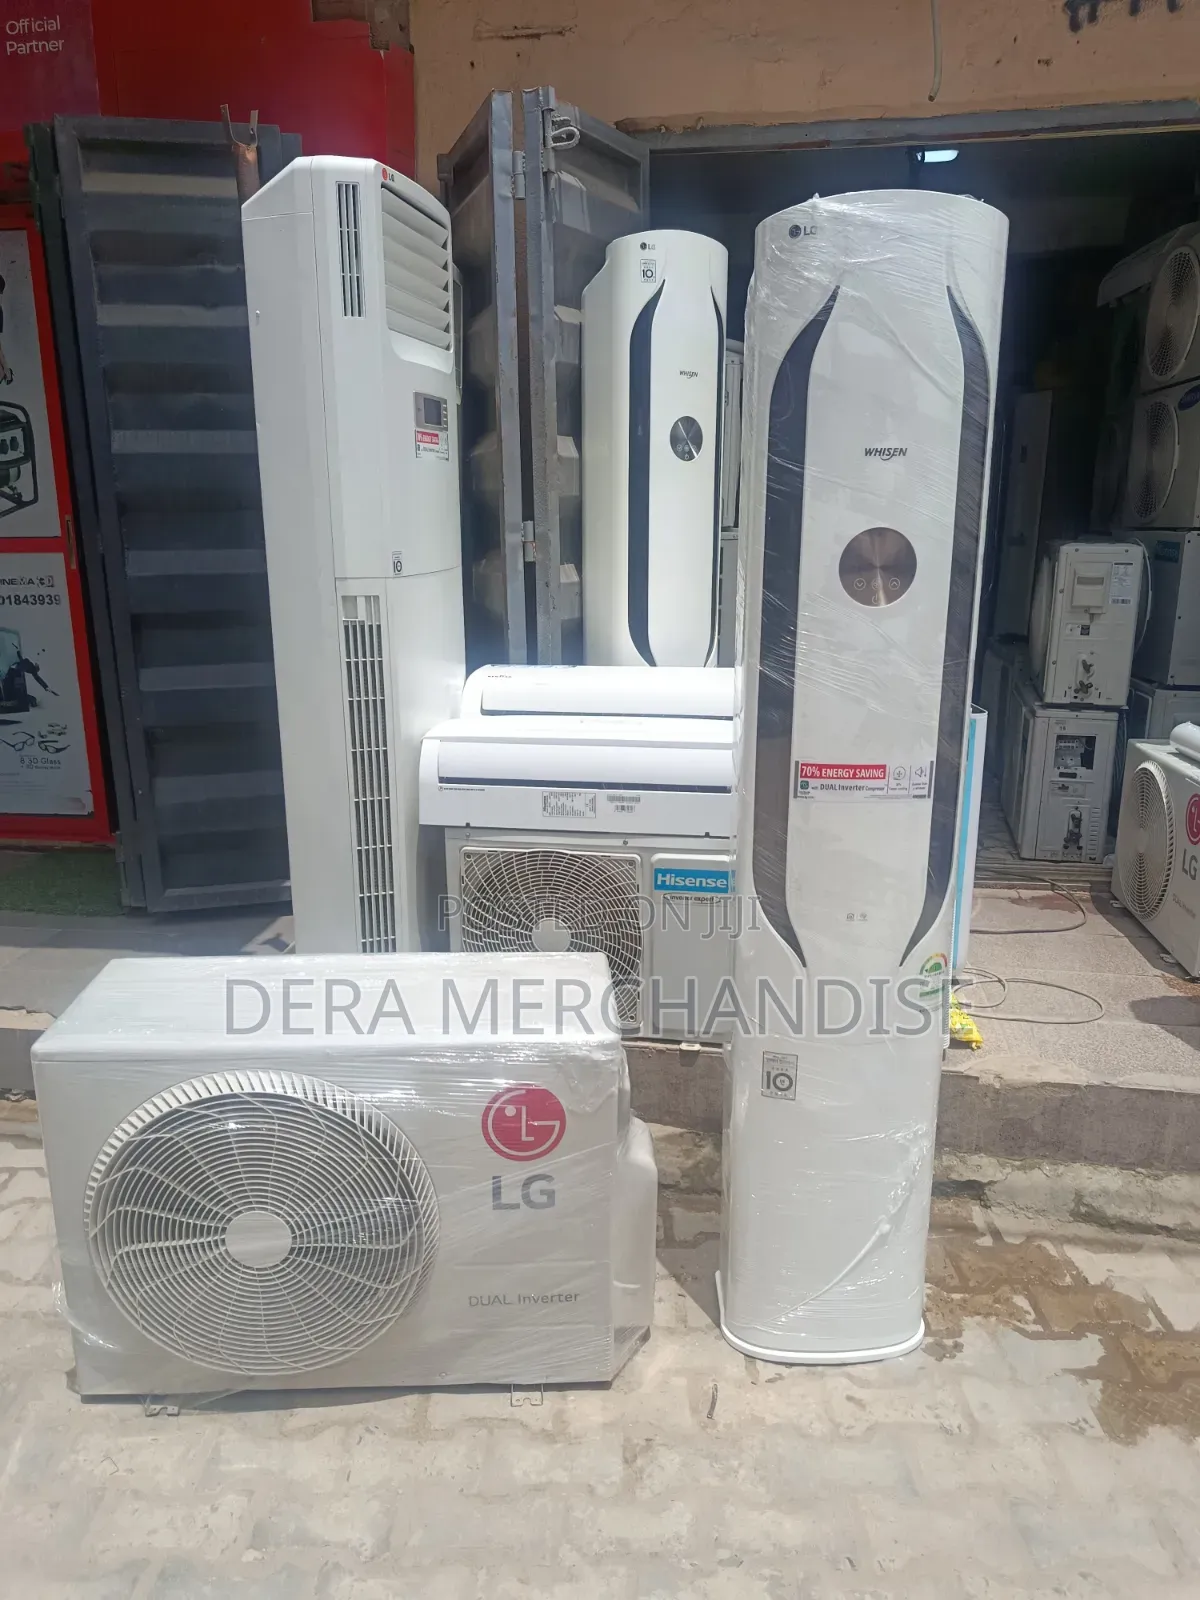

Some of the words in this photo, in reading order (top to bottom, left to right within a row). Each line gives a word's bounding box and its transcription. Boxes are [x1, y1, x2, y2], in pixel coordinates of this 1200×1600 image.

[6, 15, 60, 35] Official
[6, 40, 65, 55] Partner
[864, 447, 908, 460] WHISEN
[801, 765, 820, 778] 70%
[821, 768, 854, 778] ENERGY
[855, 768, 885, 779] SAVING
[820, 783, 838, 791] DUAL
[838, 784, 865, 792] Inverter
[1182, 848, 1199, 881] LG
[656, 873, 728, 888] Hisense
[492, 1173, 556, 1211] LG
[467, 1294, 513, 1307] DUAL
[517, 1293, 580, 1305] Inverter
